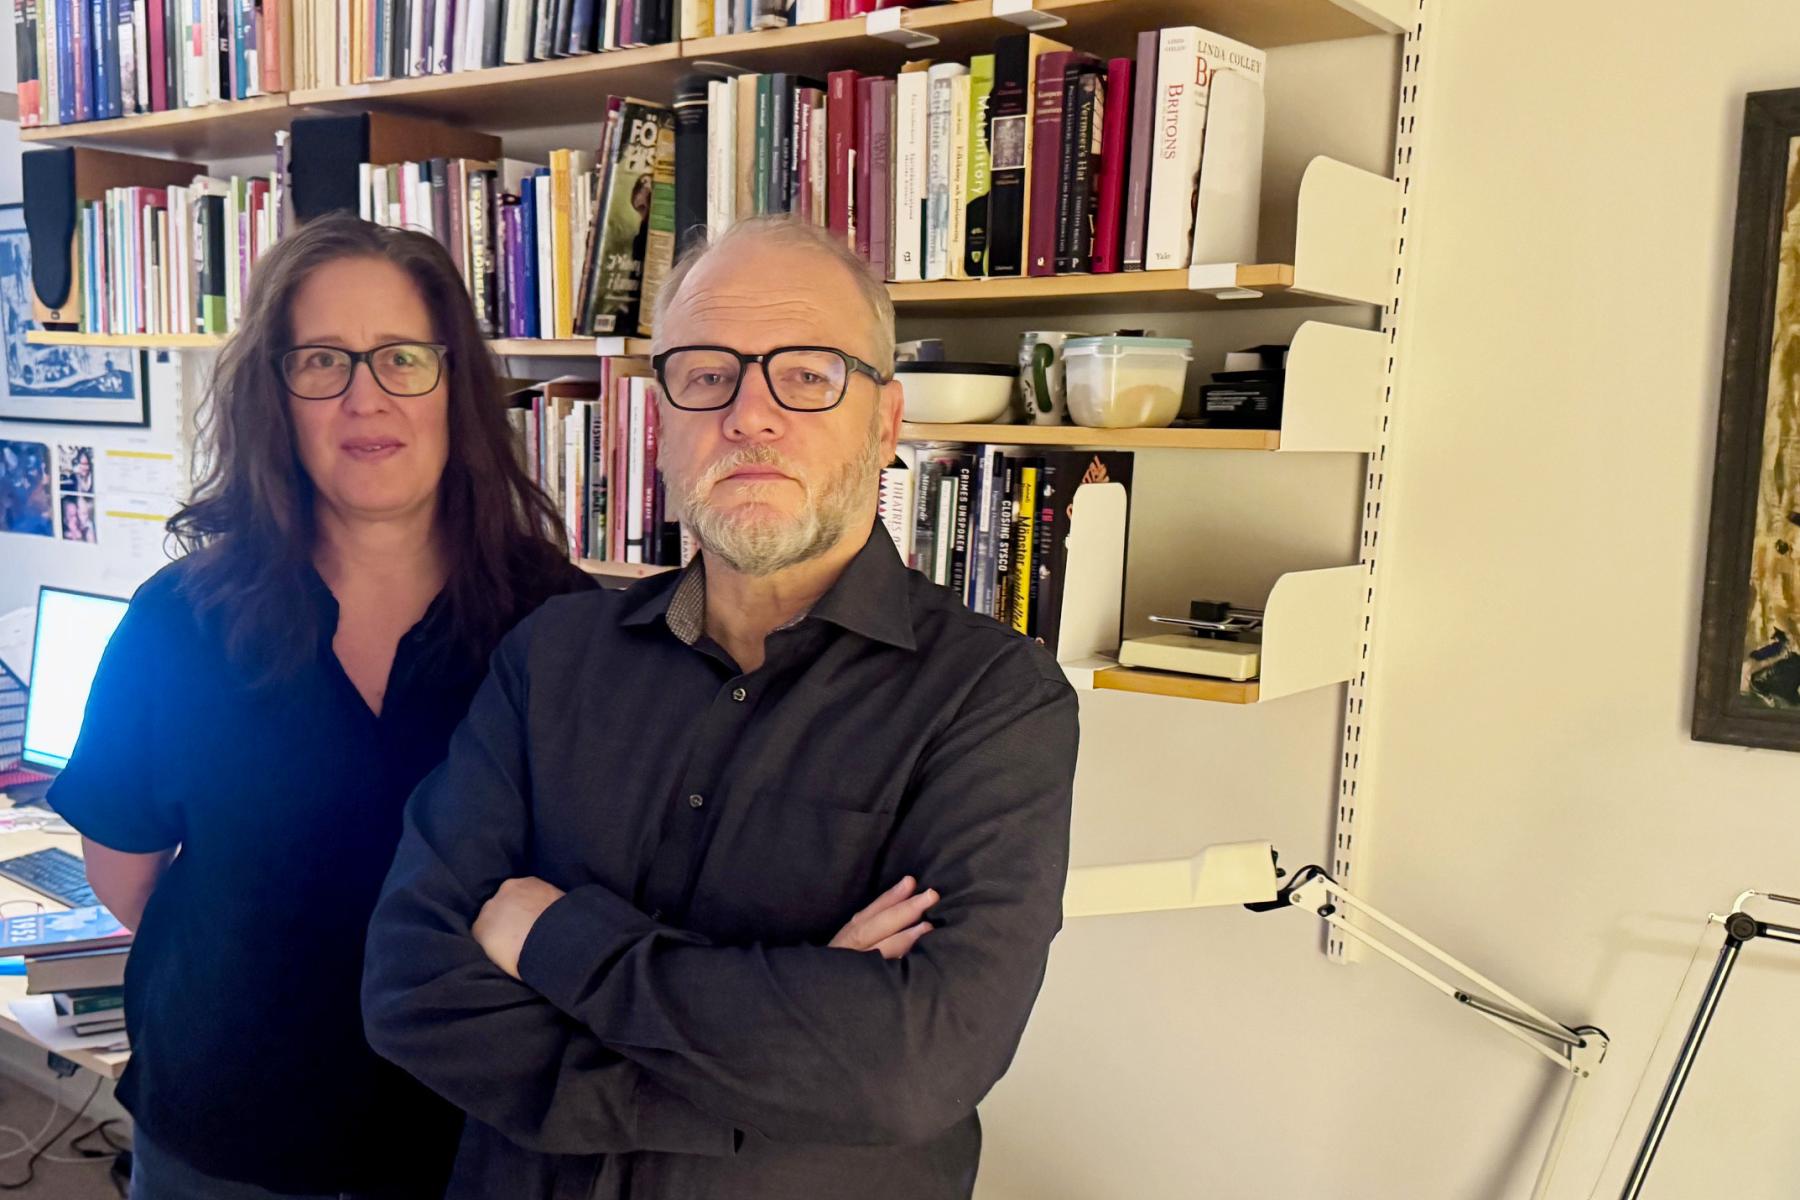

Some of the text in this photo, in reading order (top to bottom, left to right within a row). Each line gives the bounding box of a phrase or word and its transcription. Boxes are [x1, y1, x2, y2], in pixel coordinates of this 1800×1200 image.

[1197, 40, 1225, 62] LINDA
[1229, 51, 1262, 74] COLLEY
[971, 95, 990, 195] Metahistory
[1077, 101, 1091, 158] Vermeer's
[1164, 83, 1184, 160] BRITONS
[1076, 160, 1088, 182] Hat
[958, 468, 970, 552] CRIMES UNSPOKEN
[1001, 500, 1012, 539] CLOSING
[999, 542, 1010, 572] SYSCO
